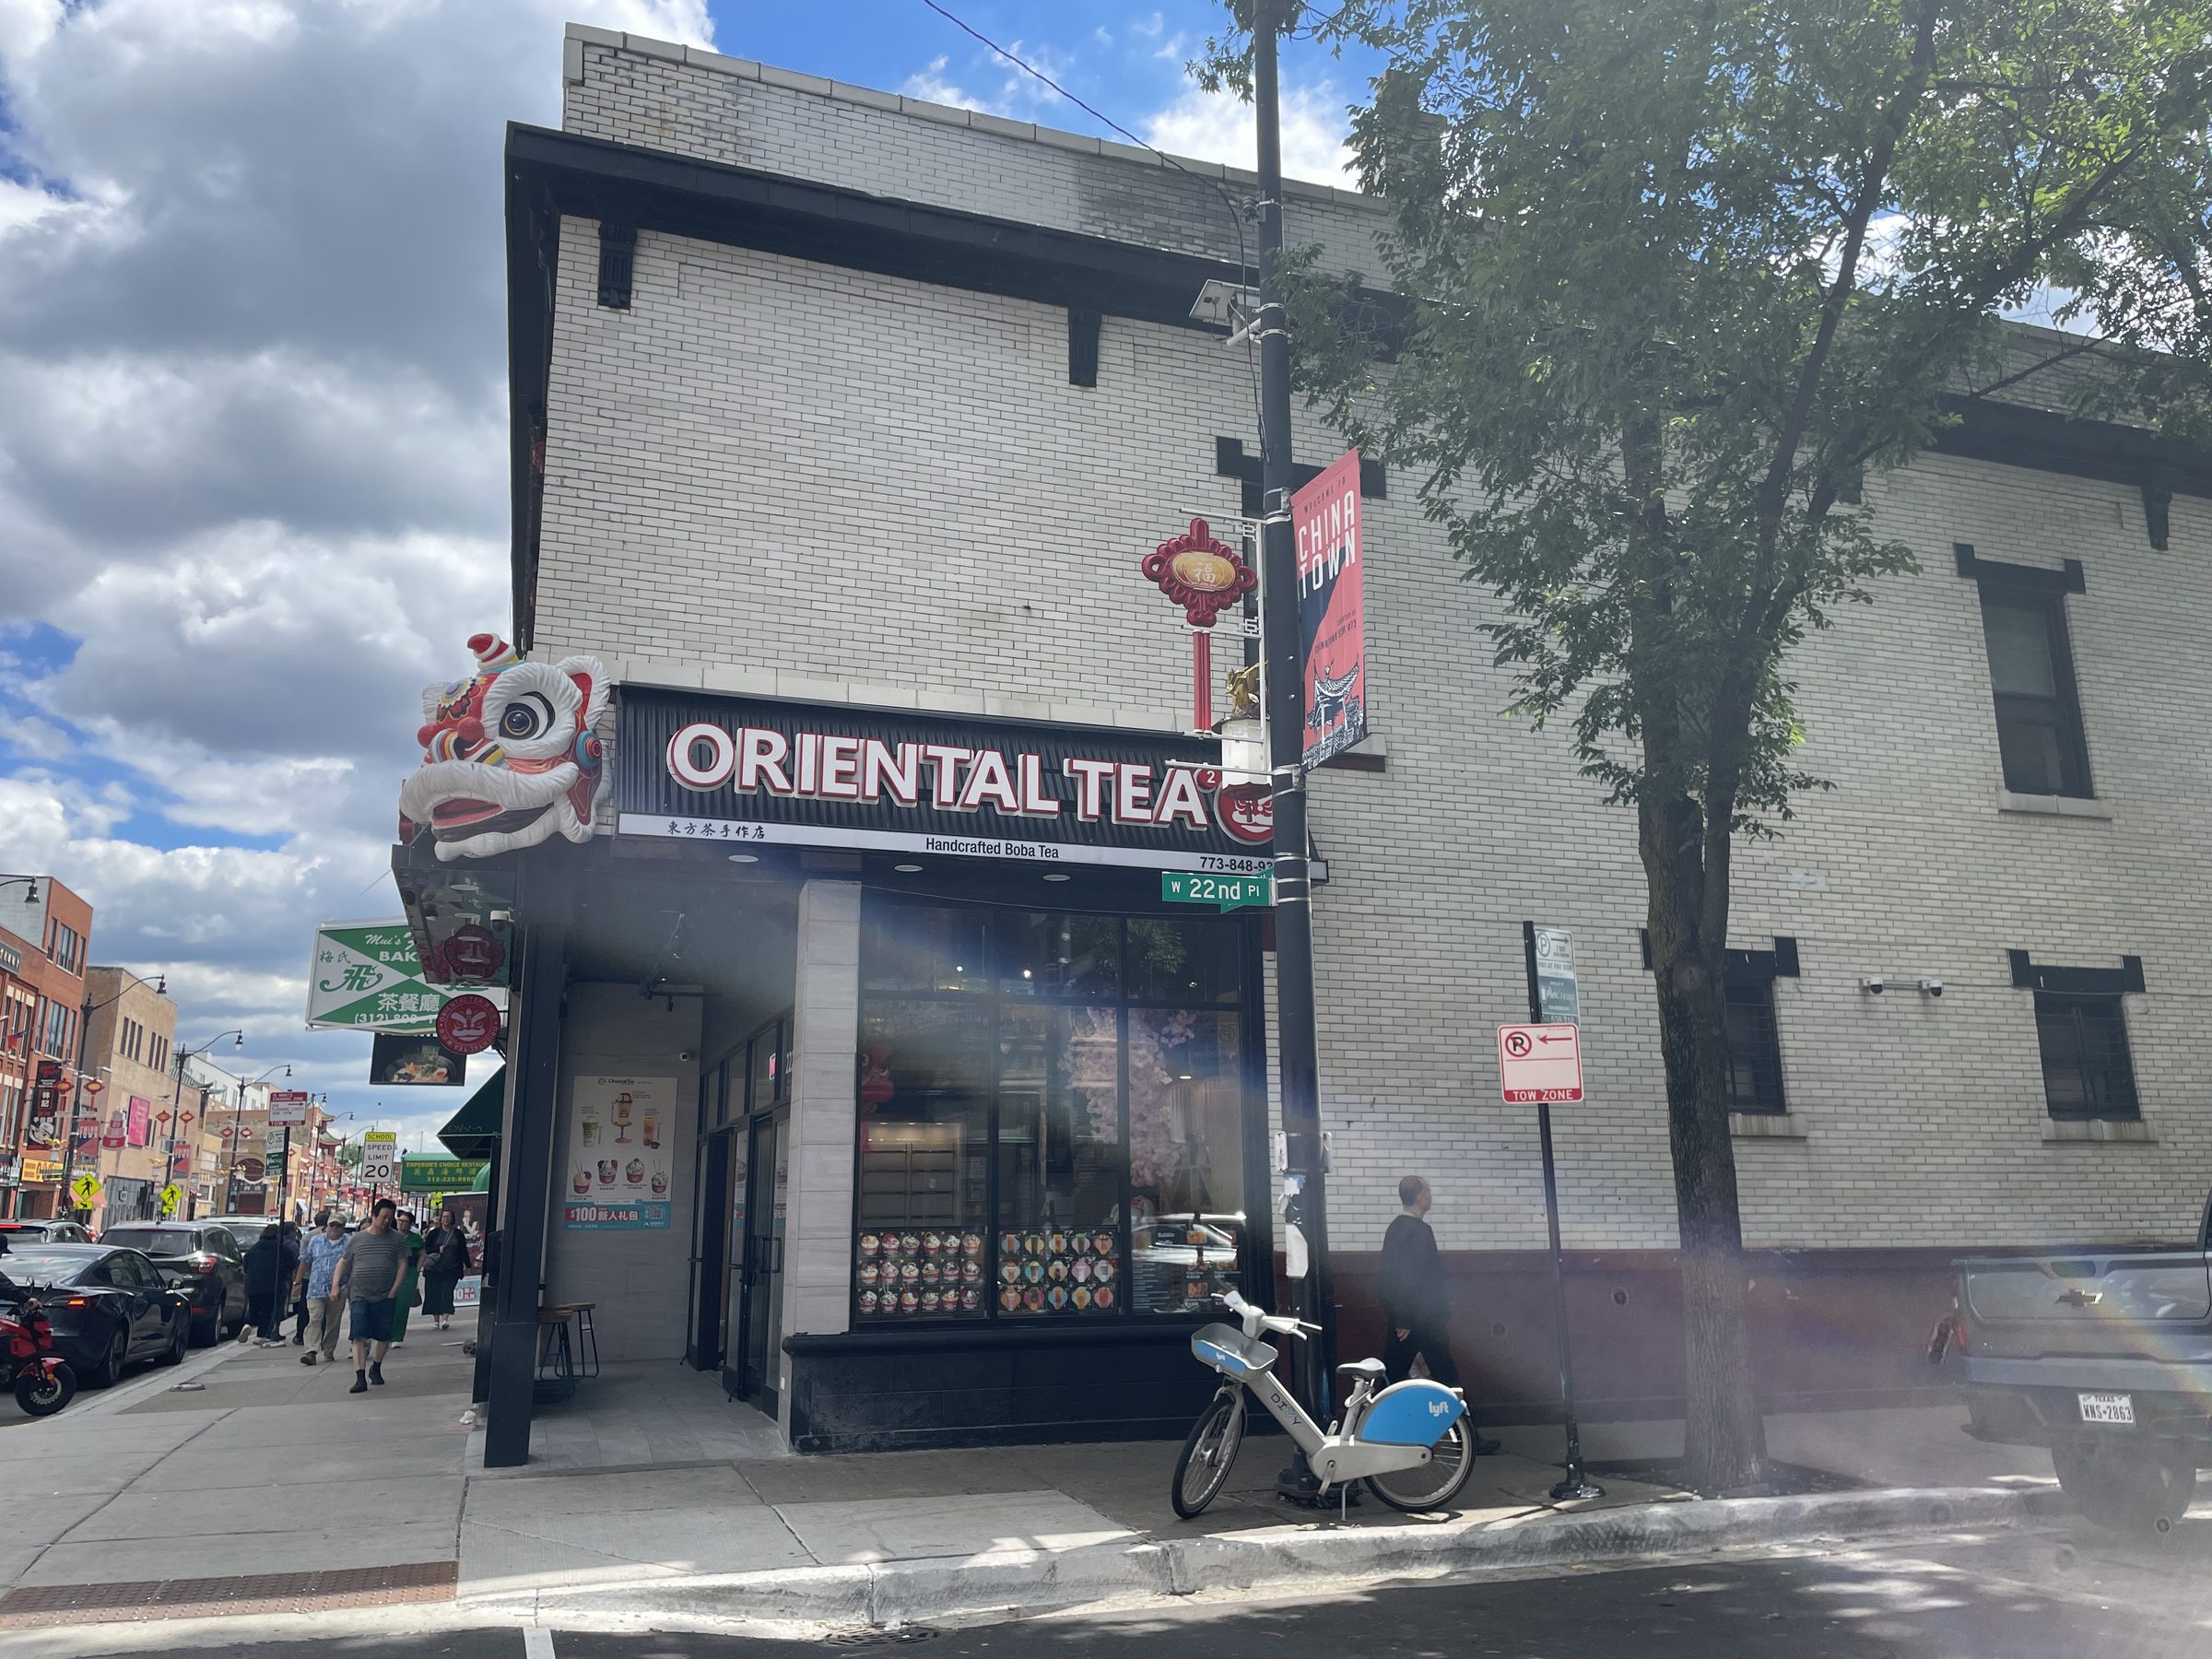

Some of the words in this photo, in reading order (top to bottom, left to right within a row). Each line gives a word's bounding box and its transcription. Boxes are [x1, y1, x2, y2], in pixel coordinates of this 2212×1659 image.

[1298, 489, 1355, 562] CHINA
[1299, 526, 1356, 599] TOWN
[1193, 561, 1217, 583] 福
[666, 722, 1060, 818] ORIENTAL
[1064, 758, 1209, 830] TEA
[1206, 771, 1216, 783] 2
[667, 820, 766, 840] 東方茶手作店
[925, 837, 1001, 855] Handcrafted
[1005, 842, 1036, 857] Boba
[1038, 845, 1059, 858] Tea
[1171, 881, 1181, 893] W
[1190, 878, 1241, 900] 22nd
[364, 934, 402, 945] Mui's
[379, 951, 420, 961] BAK
[377, 993, 441, 1011] 茶餐廳
[1512, 1090, 1536, 1101] TOW
[1542, 1089, 1573, 1100] ZONE
[364, 1165, 389, 1178] 20
[570, 1206, 596, 1221] $100
[1428, 1401, 1450, 1417] lyft
